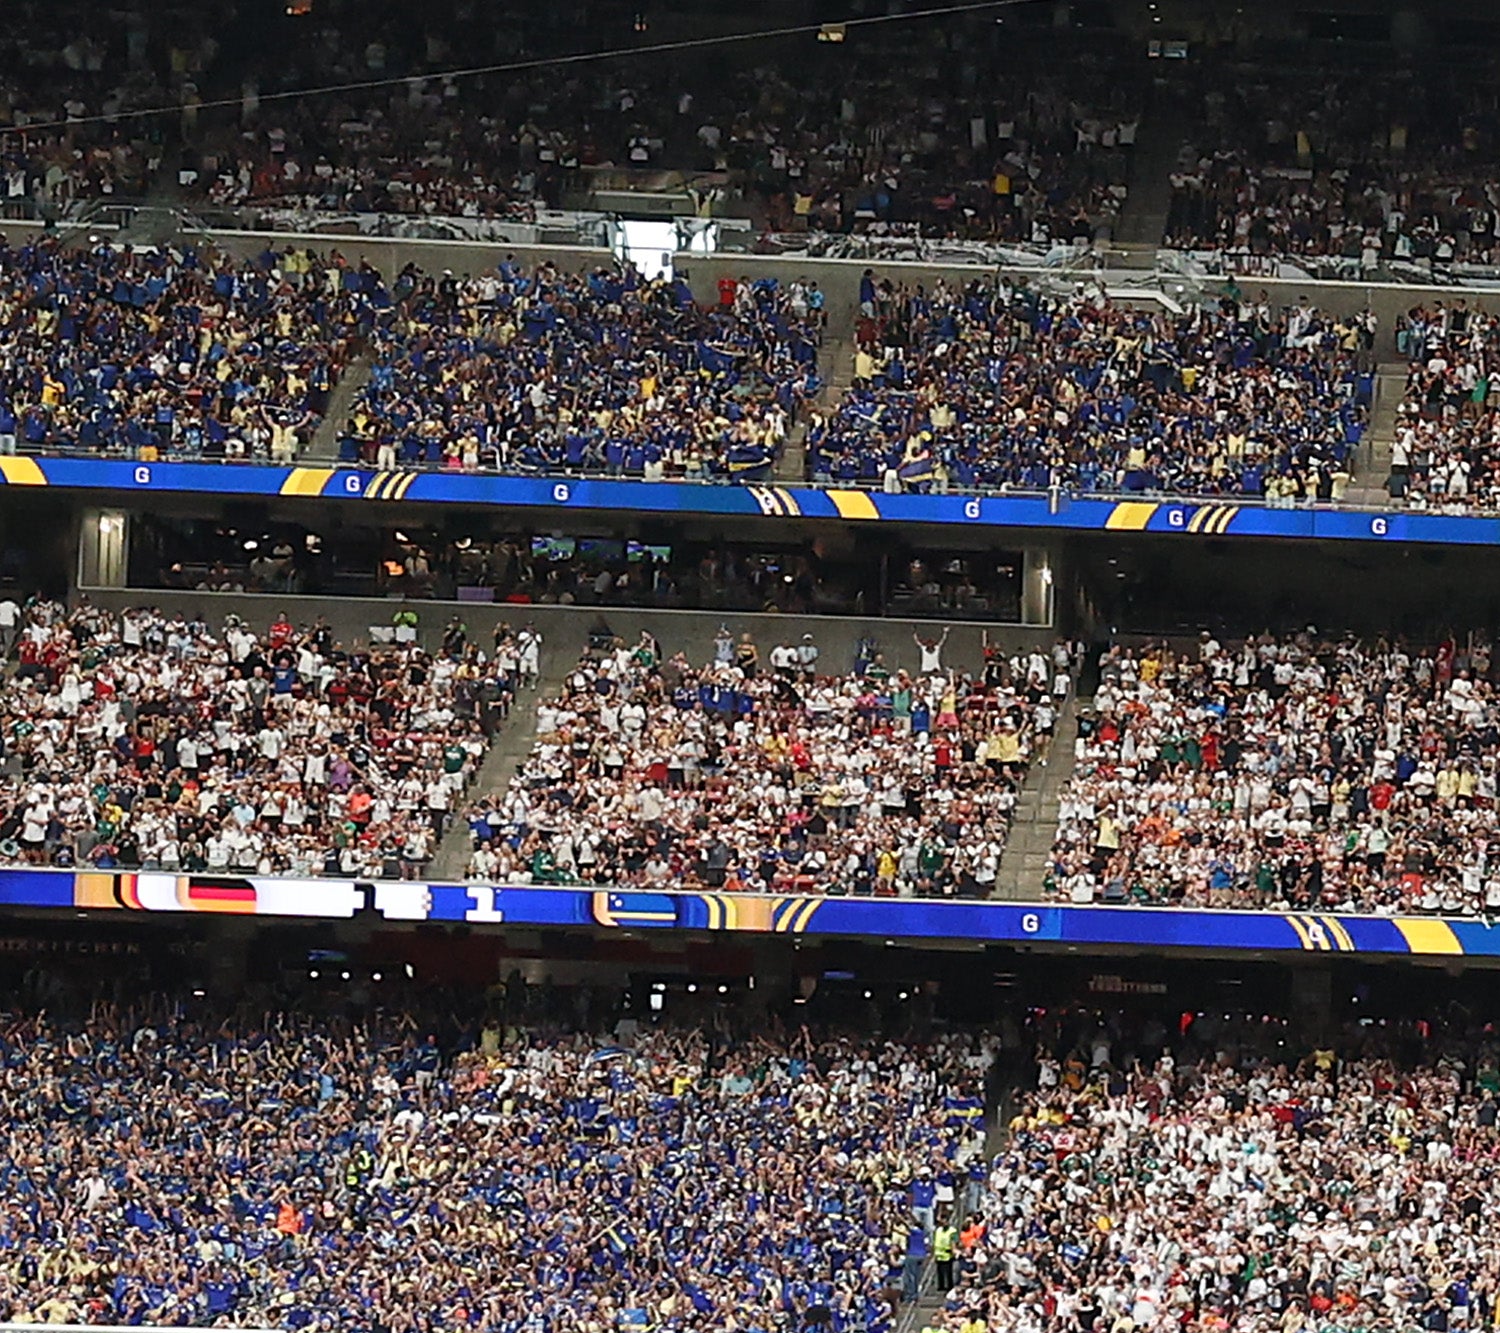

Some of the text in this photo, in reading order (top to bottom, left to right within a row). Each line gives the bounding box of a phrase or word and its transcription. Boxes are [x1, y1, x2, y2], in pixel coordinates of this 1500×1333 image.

[135, 467, 149, 482] G
[346, 476, 360, 492] G
[554, 484, 569, 500] G
[965, 502, 979, 518] G
[1169, 512, 1183, 526] G
[1372, 519, 1386, 535] G
[466, 886, 502, 922] 1
[1022, 914, 1039, 932] G
